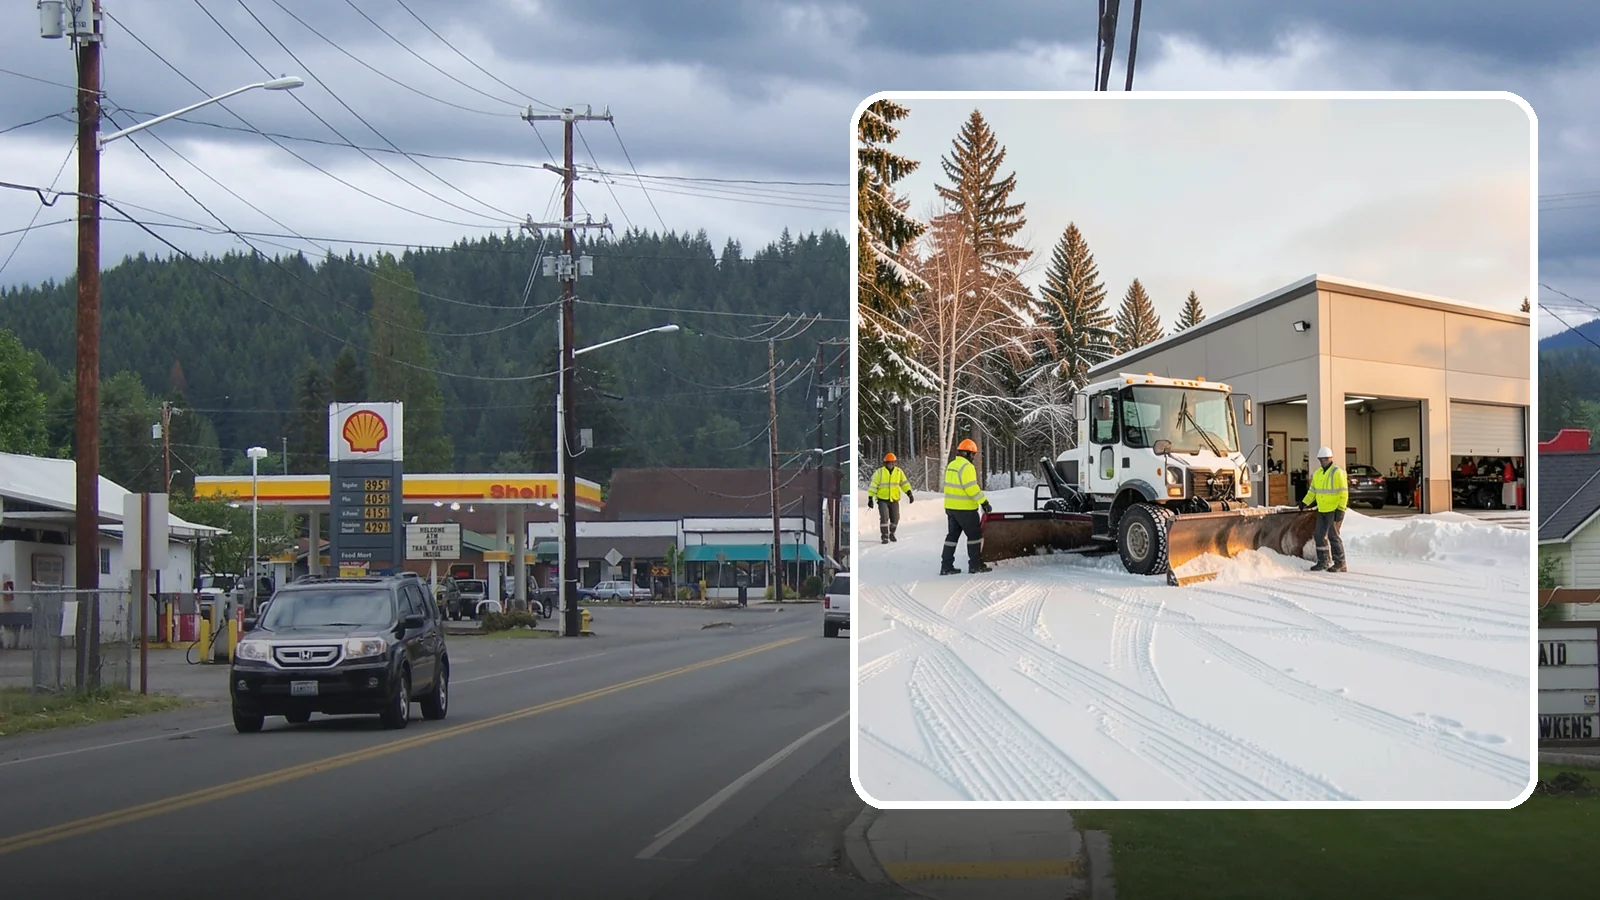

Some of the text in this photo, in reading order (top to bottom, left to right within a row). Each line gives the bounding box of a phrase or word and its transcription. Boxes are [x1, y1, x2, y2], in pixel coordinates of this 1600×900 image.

[366, 480, 383, 490] 395
[490, 484, 547, 499] Shell
[366, 494, 383, 504] 405
[366, 508, 383, 518] 415
[366, 522, 383, 532] 429
[1539, 643, 1567, 665] AID
